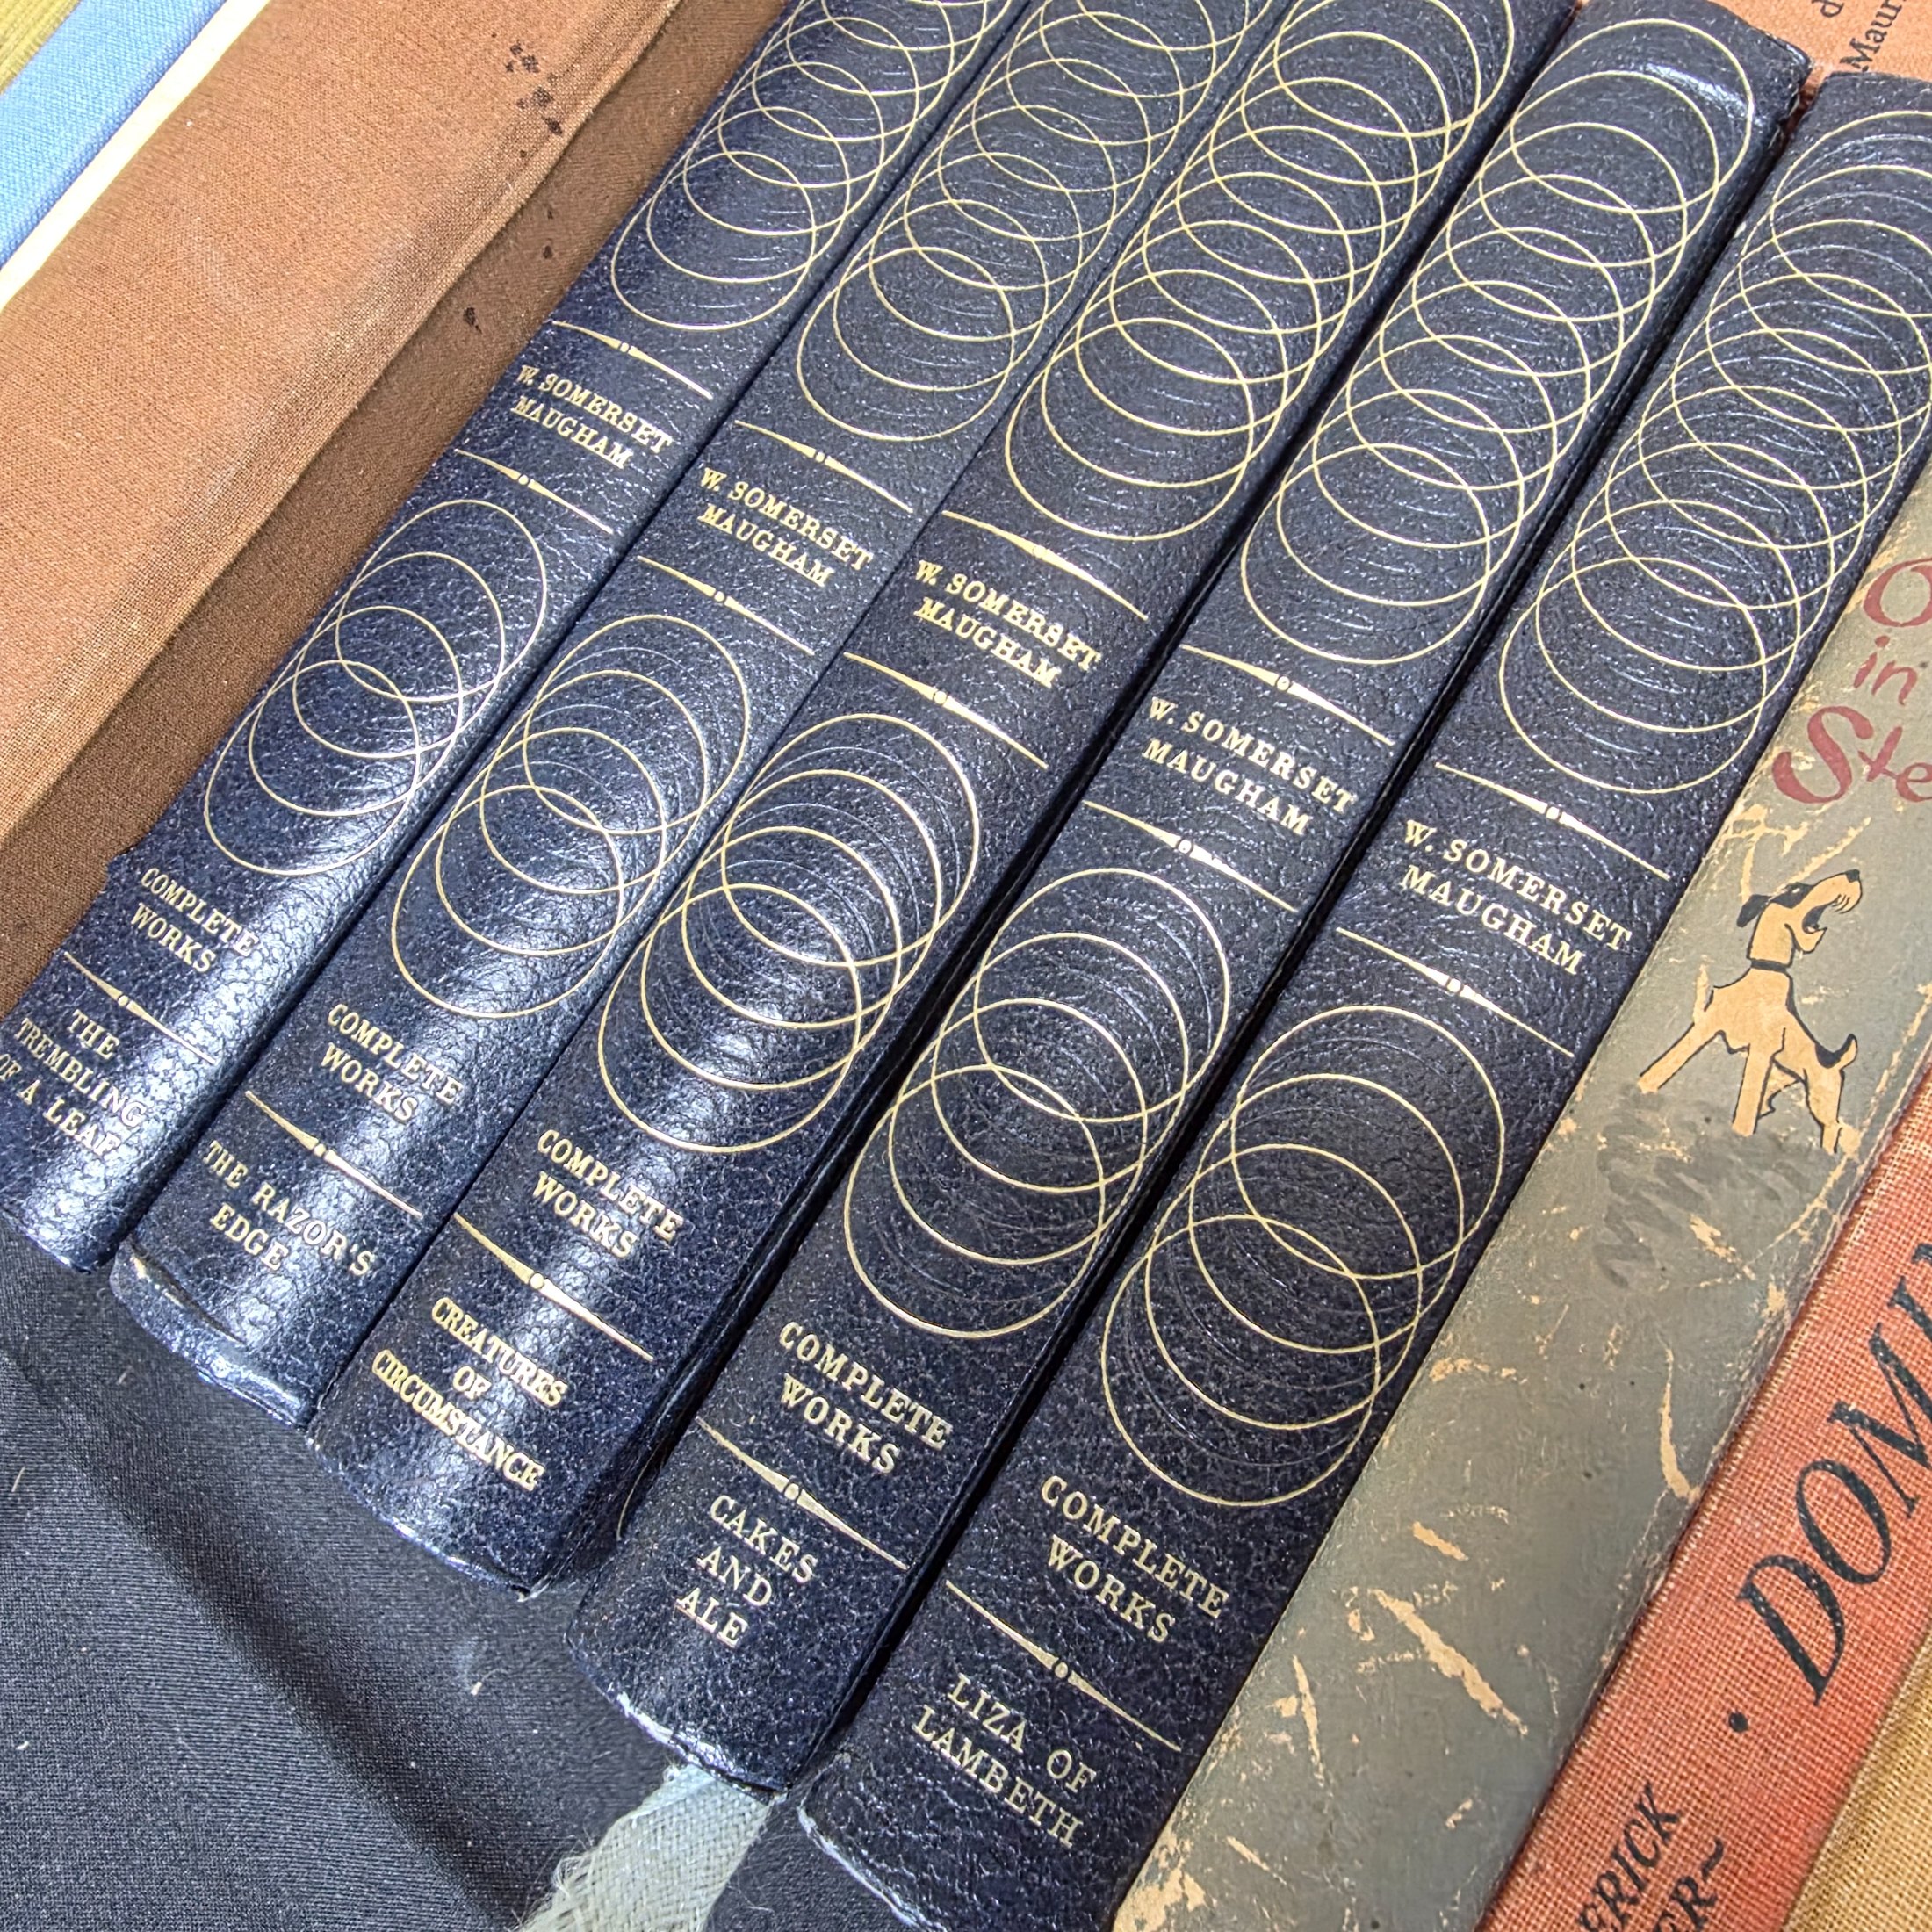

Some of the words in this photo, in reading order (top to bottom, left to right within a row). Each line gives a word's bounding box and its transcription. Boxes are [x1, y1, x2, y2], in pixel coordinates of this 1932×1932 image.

[1840, 0, 1907, 72] Maur
[510, 395, 634, 469] MAUGHAM
[516, 364, 540, 386] W.
[538, 373, 673, 454] SOMERSET
[697, 503, 835, 588] MAUGHAM
[701, 466, 727, 493] W.
[728, 480, 874, 572] SOMERSET
[912, 597, 1062, 689] MAUGHAM
[915, 559, 943, 586] W.
[945, 573, 1101, 672] SOMERSET
[1853, 635, 1918, 707] in
[1142, 739, 1314, 836] MAUGHAM
[1149, 696, 1178, 725] W.
[1181, 711, 1358, 814] SOMERSET
[141, 867, 260, 957] COMPLETE
[1401, 865, 1586, 975] MAUGHAM
[1404, 818, 1437, 853] W.
[1443, 839, 1632, 951] SOMERSET
[131, 902, 217, 973] WORKS
[14, 1017, 147, 1128] TREMBLING
[67, 1009, 120, 1060] THE
[320, 1043, 420, 1123] WORKS
[328, 1003, 465, 1107] COMPLETE
[17, 1079, 40, 1106] A
[43, 1097, 122, 1157] LEAF
[203, 1140, 249, 1189] THE
[251, 1182, 376, 1276] RAZOR'S
[532, 1171, 638, 1258] WORKS
[537, 1129, 685, 1242] COMPLETE
[210, 1202, 289, 1271] EDGE
[431, 1297, 569, 1408] CREATURES
[452, 1366, 492, 1402] OF
[779, 1322, 954, 1452] COMPLETE
[371, 1349, 545, 1492] CIRCUMSTANCE
[780, 1374, 901, 1475] WORKS
[696, 1545, 773, 1607] AND
[710, 1494, 818, 1583] CAKES
[1041, 1474, 1229, 1620] COMPLETE
[674, 1590, 749, 1648] ALE
[1047, 1534, 1177, 1644] WORKS
[912, 1705, 1085, 1848] LAMBETH
[947, 1673, 1025, 1754] LIZA
[1046, 1749, 1098, 1794] OF
